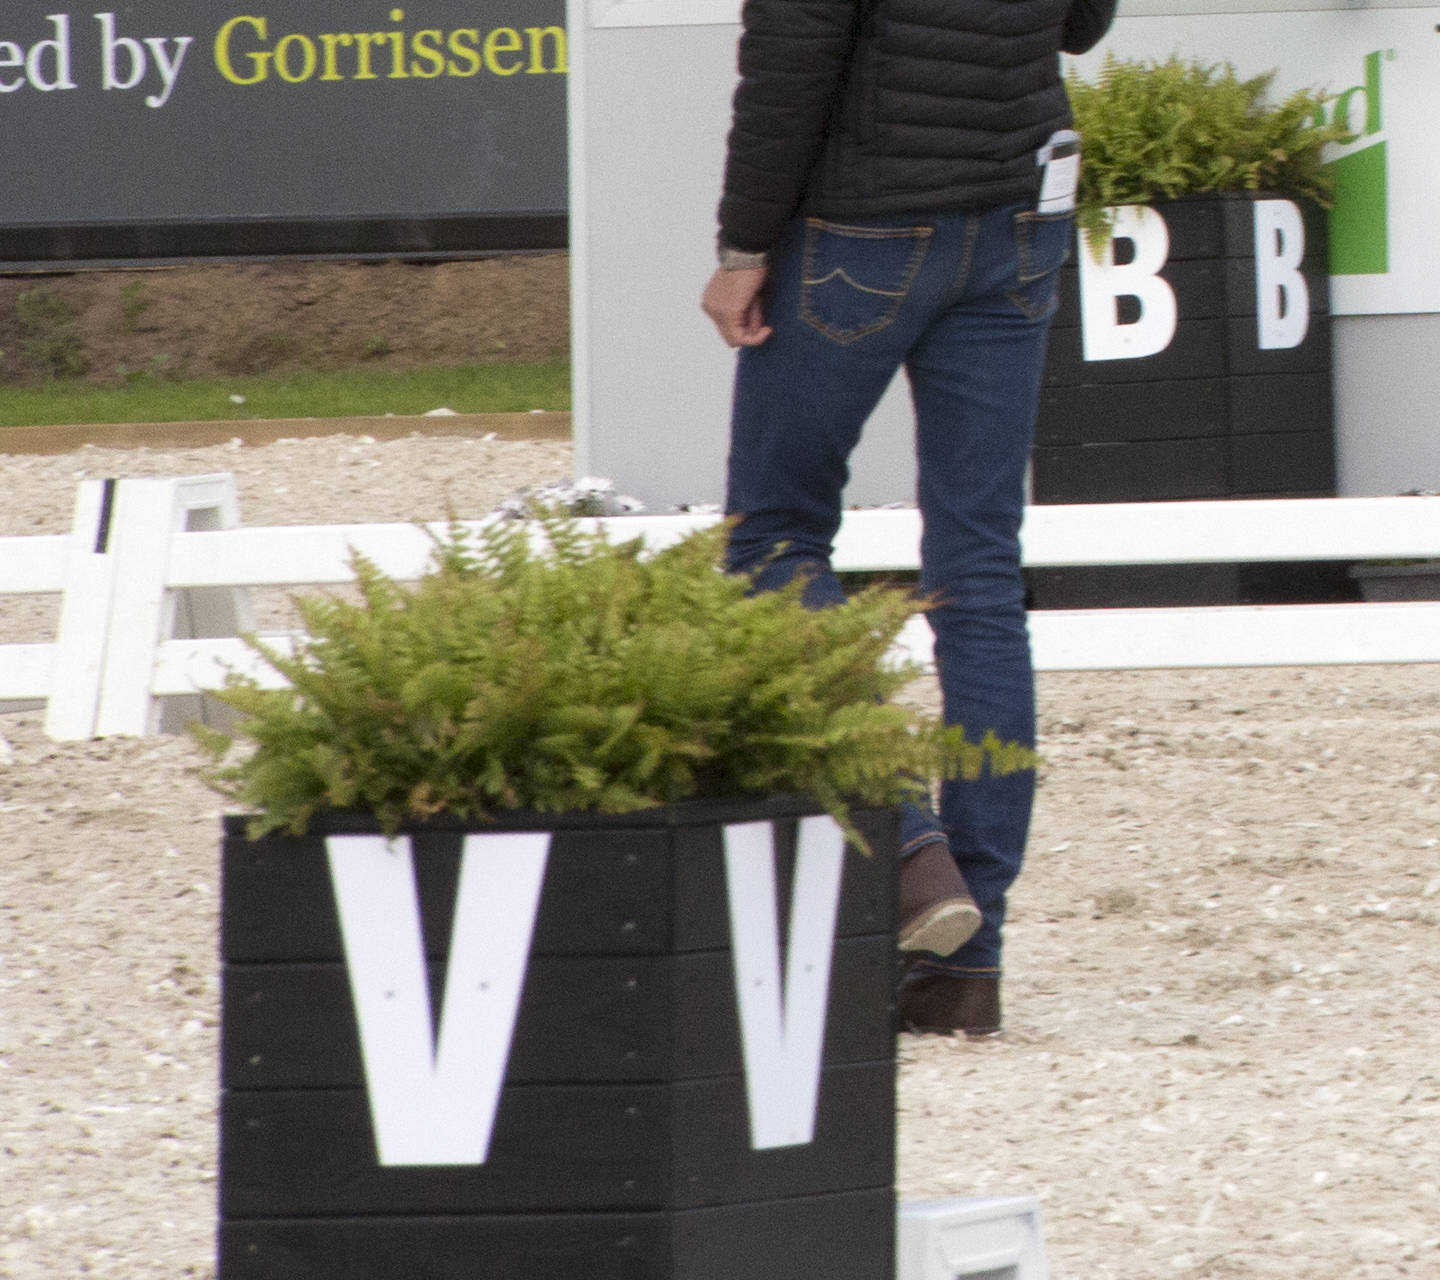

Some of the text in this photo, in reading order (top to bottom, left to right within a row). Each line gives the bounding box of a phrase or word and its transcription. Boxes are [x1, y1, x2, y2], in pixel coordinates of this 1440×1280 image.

[92, 11, 194, 109] by
[212, 8, 568, 87] Gorrissen
[1079, 199, 1310, 363] B B
[325, 813, 845, 1167] V V
